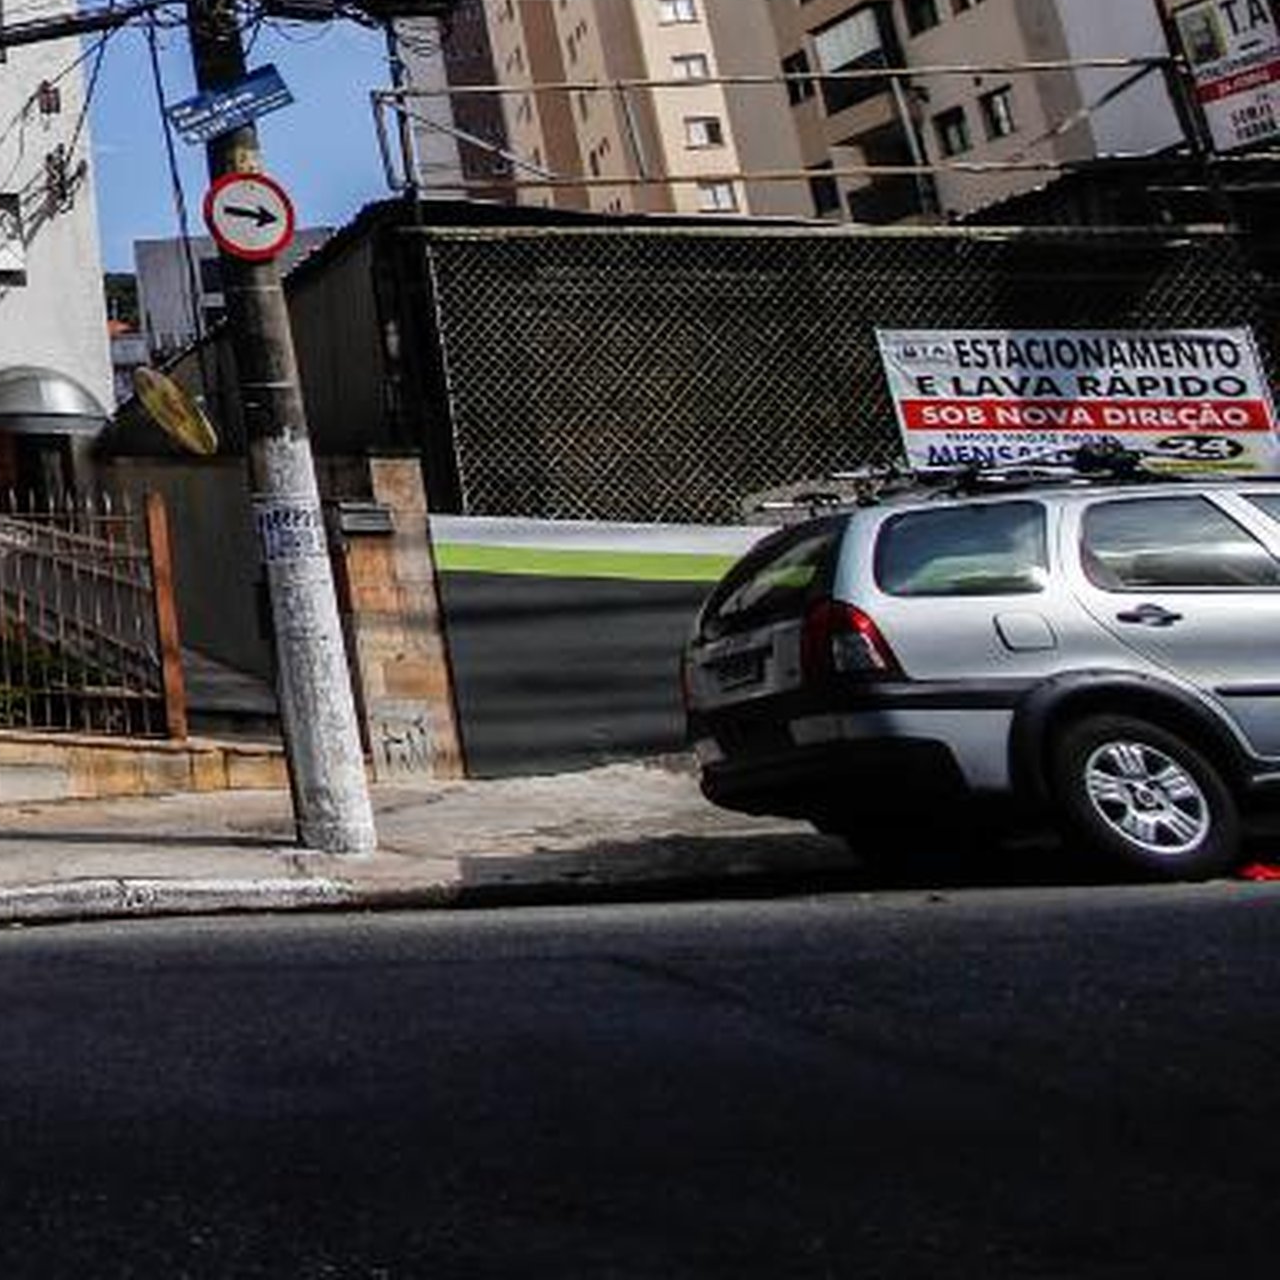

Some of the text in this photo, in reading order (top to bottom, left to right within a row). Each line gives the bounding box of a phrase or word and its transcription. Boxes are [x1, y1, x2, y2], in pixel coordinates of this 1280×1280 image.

[953, 337, 1241, 370] ESTACIONAMENTO
[916, 368, 1248, 398] E LAVA RÁPIDO
[921, 402, 1250, 431] SOB NOVA DIREÇÃO
